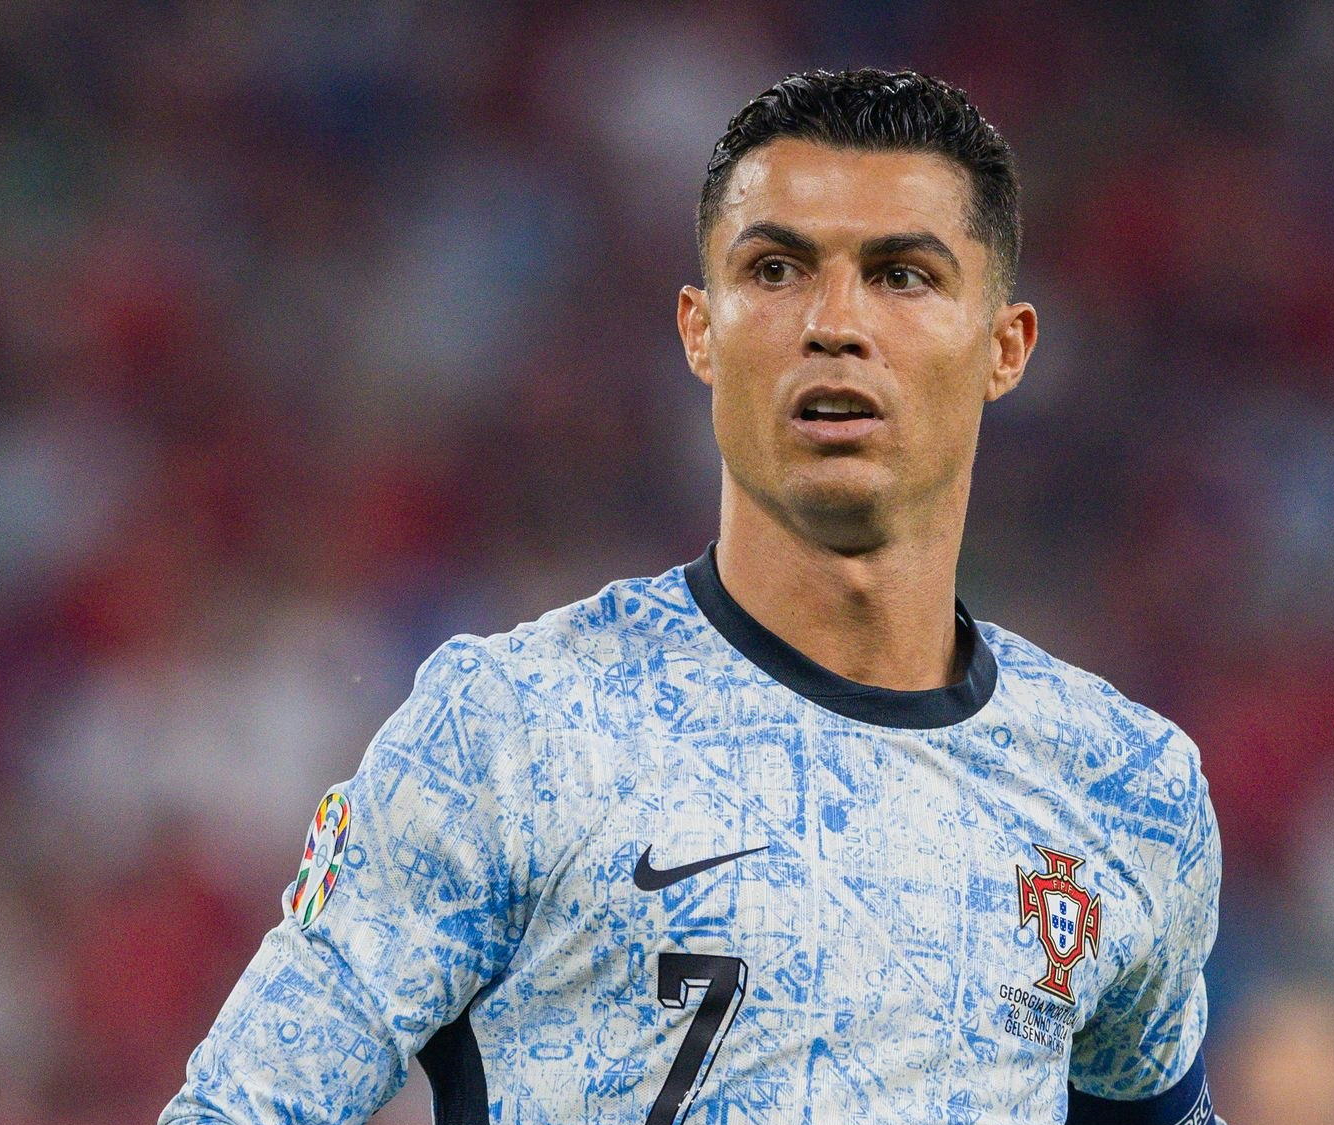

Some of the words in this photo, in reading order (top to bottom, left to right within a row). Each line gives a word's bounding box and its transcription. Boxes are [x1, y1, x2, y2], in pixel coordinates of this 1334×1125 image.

[1008, 1003, 1021, 1020] 26
[1023, 1010, 1051, 1033] JUNHO
[1053, 1022, 1069, 1041] 2024
